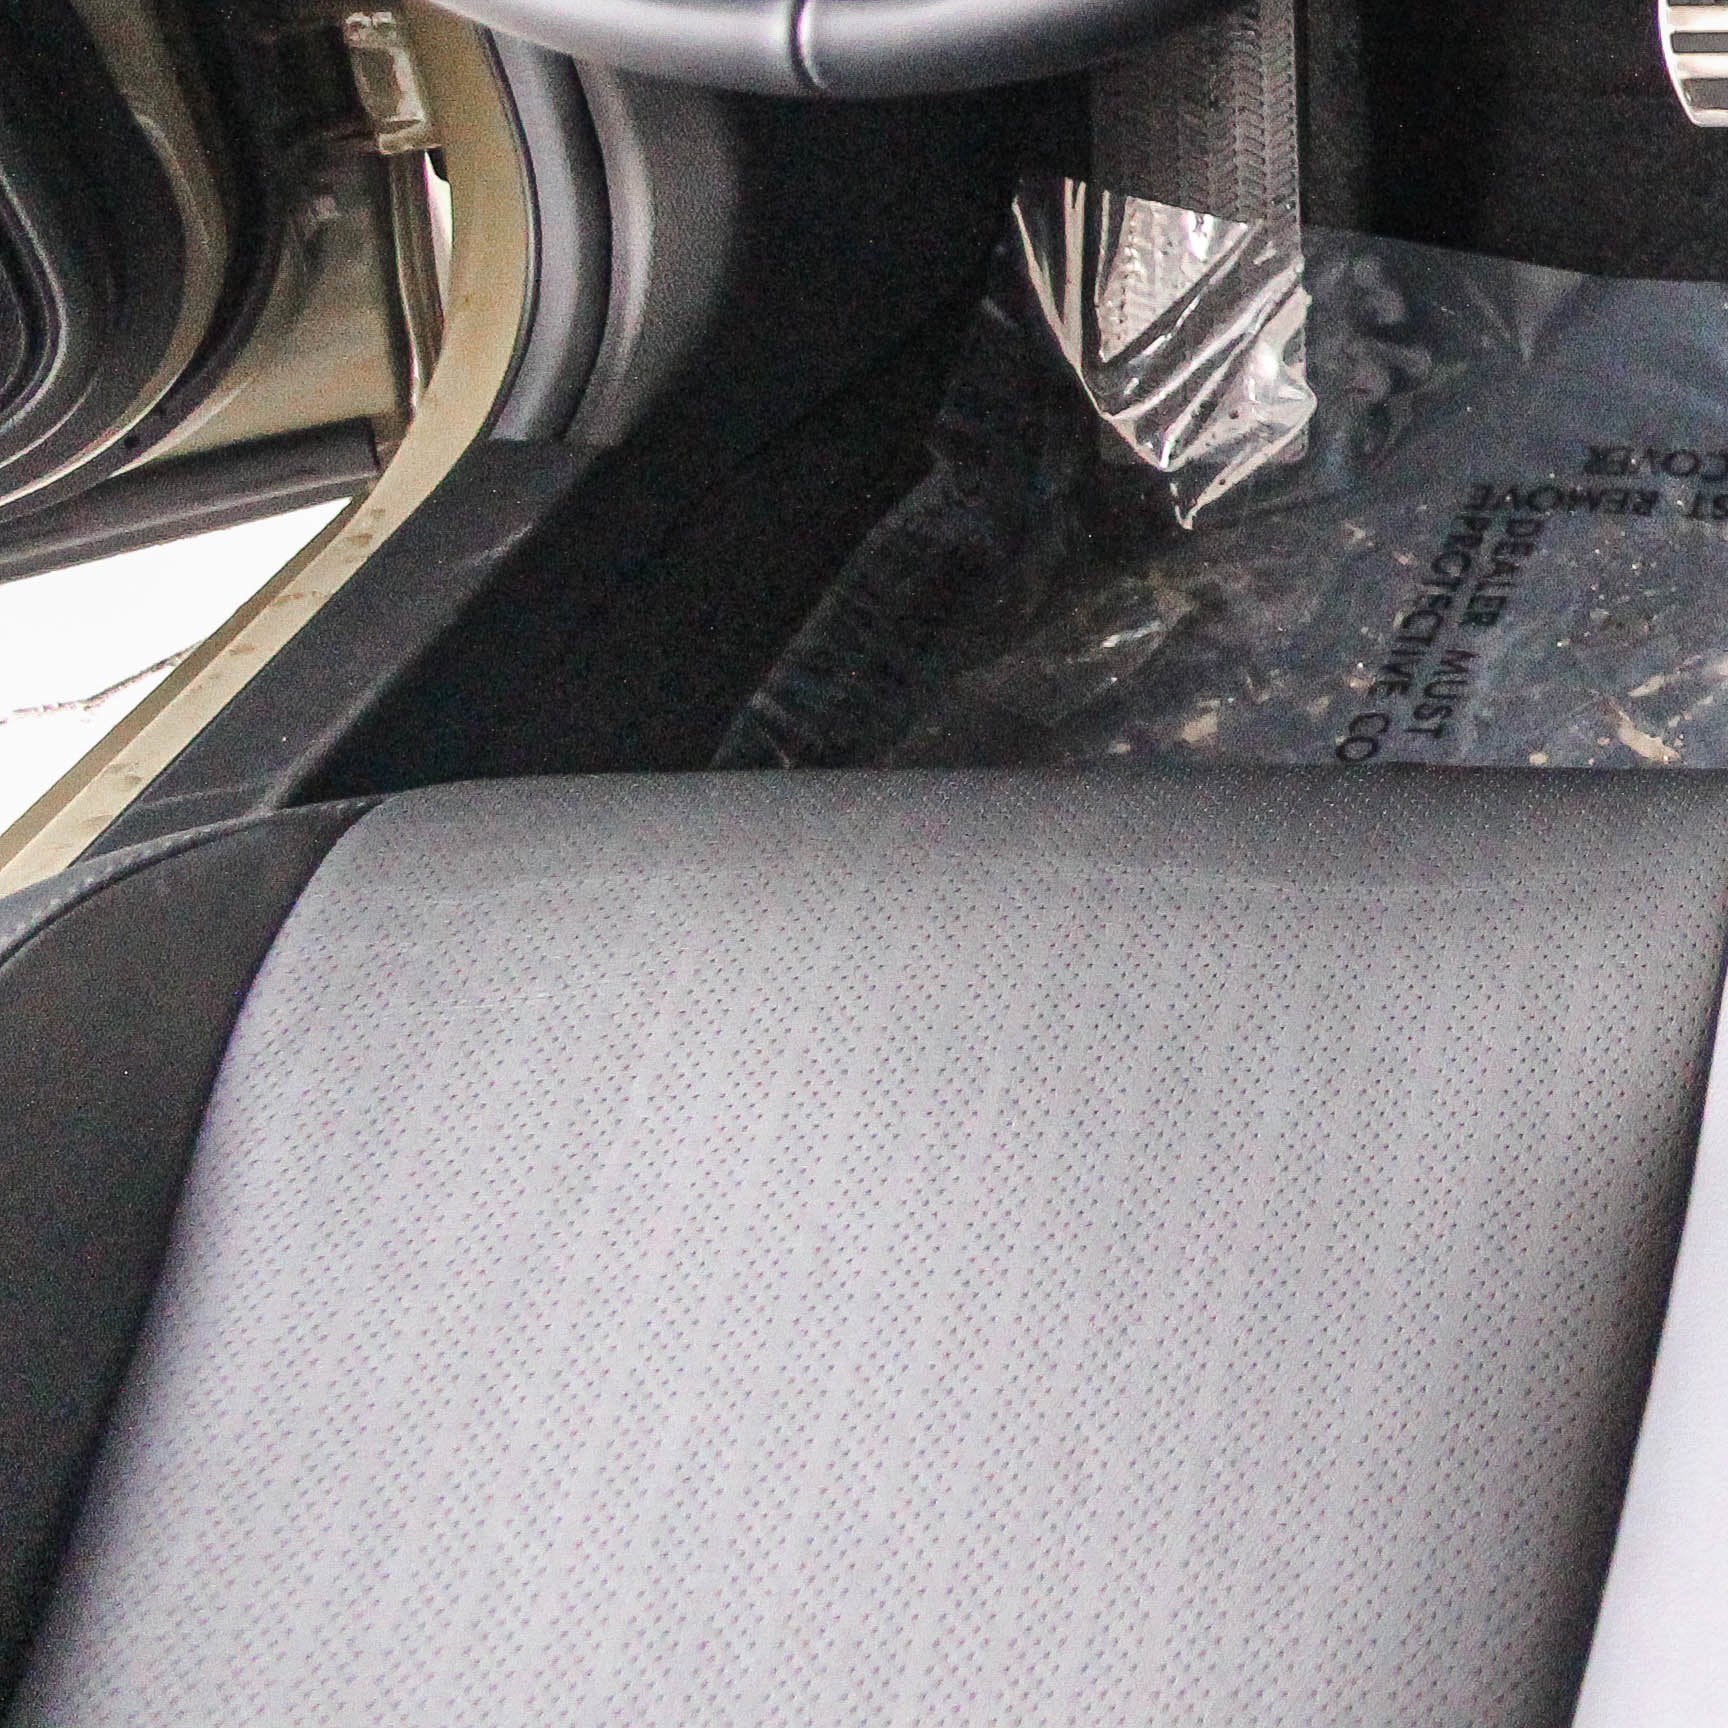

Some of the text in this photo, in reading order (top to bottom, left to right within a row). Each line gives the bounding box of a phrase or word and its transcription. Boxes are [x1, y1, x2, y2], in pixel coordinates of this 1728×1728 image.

[1466, 483, 1658, 518] REMOVE
[1407, 518, 1545, 739] DEALER MUST
